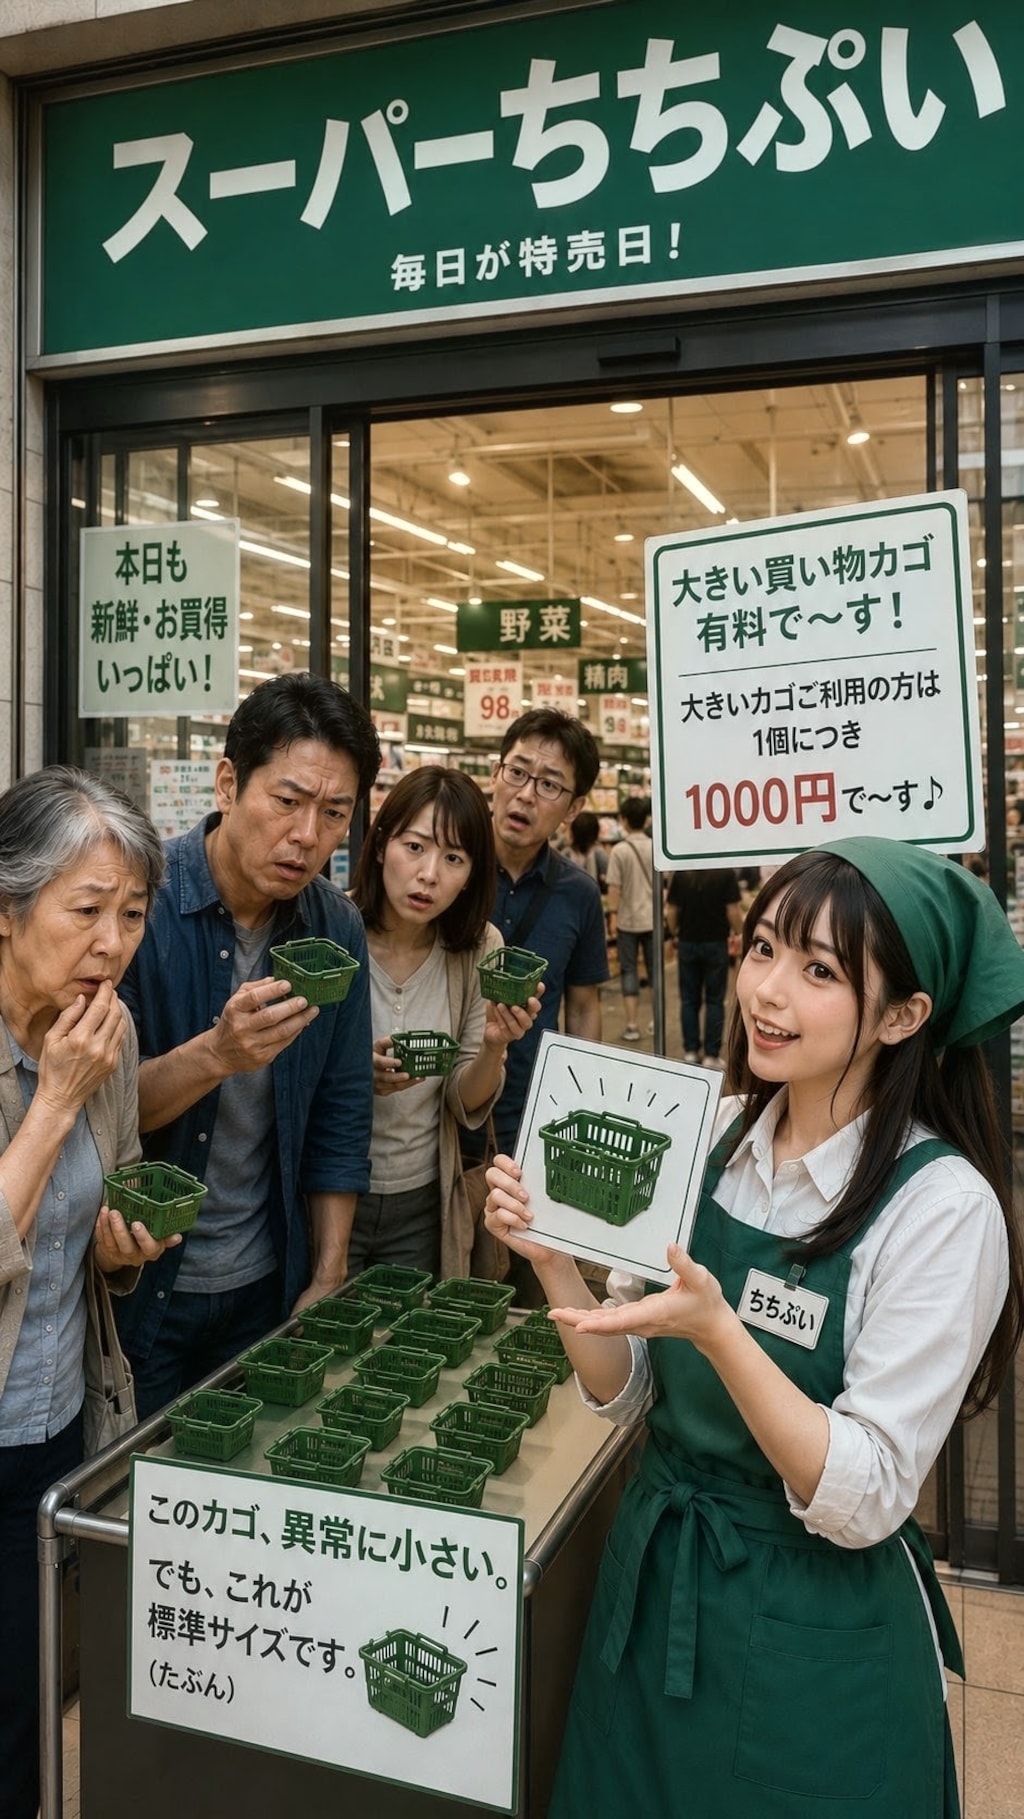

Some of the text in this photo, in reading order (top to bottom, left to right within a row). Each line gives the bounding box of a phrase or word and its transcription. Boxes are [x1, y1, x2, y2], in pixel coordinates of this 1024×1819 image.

[102, 21, 1005, 263] スーパーちちぷい
[390, 222, 681, 292] 毎日が特売日！
[115, 540, 188, 585] 本日も
[672, 533, 935, 607] 大きい買い物カゴ
[91, 596, 228, 643] 新鮮・お買得
[500, 605, 571, 643] 野菜
[98, 652, 212, 693] いっぱい！
[584, 664, 628, 689] 精肉
[681, 669, 941, 723] 大きいカゴご利用の方は
[753, 720, 862, 757] 1個につき
[750, 1288, 814, 1331] ちちぷい
[148, 1494, 507, 1590] このカゴ、異常に小さい。
[148, 1557, 312, 1614] でも、これが
[148, 1602, 355, 1679] 標準サイズです。
[149, 1659, 235, 1704] (たぶん)
